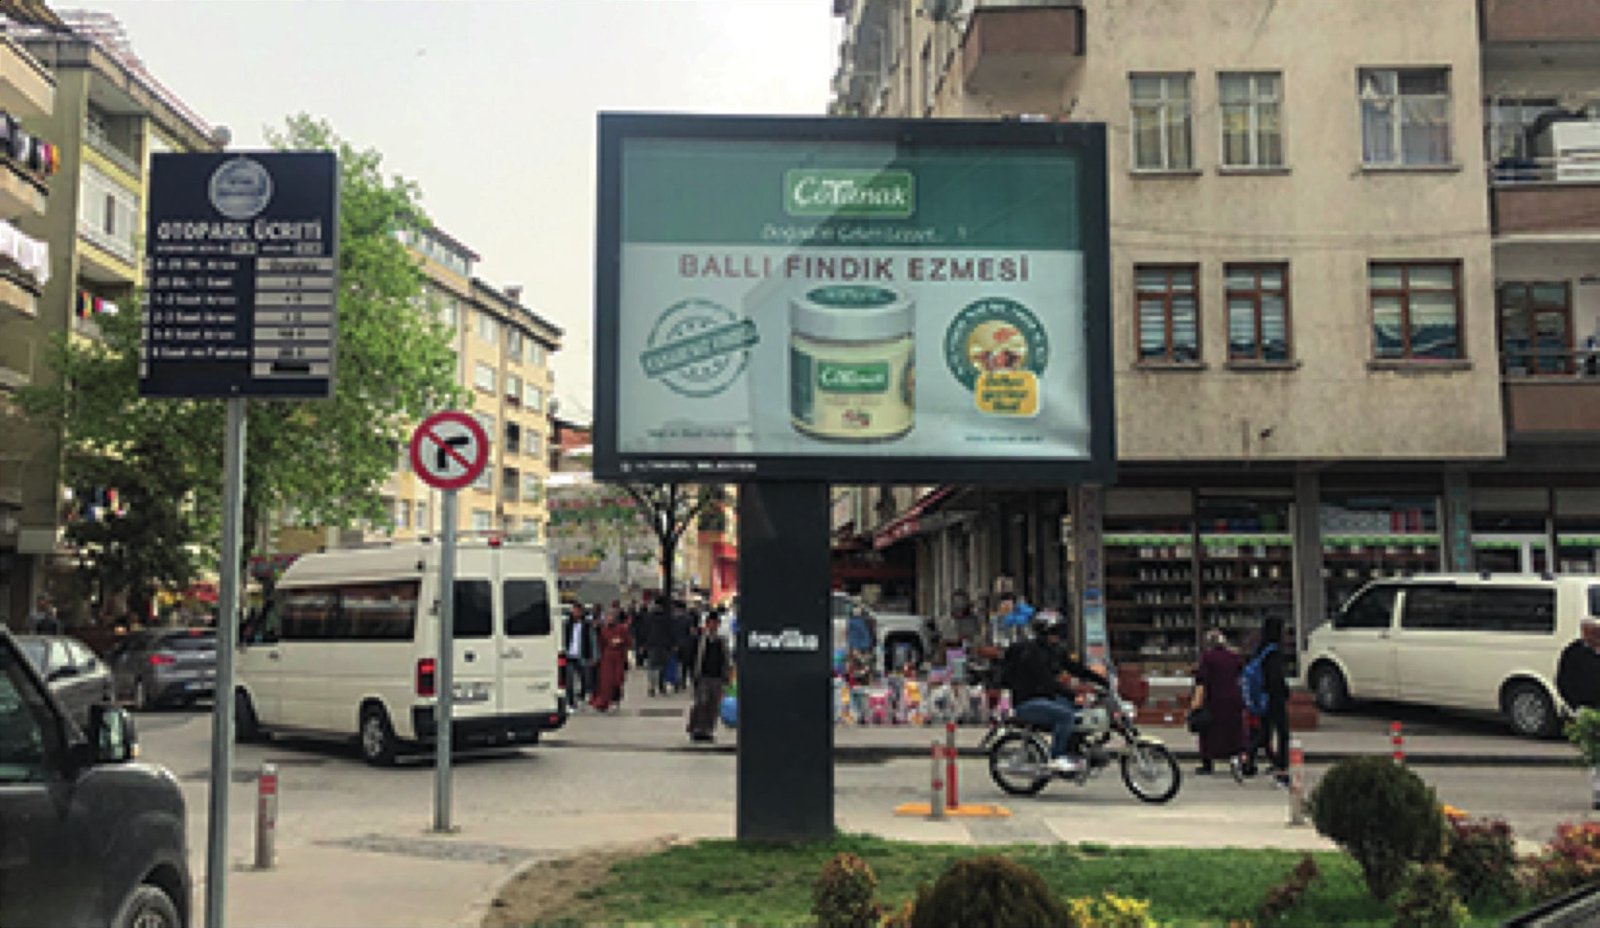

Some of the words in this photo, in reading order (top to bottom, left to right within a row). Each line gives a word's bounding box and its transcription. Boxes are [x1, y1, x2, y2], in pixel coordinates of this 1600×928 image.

[157, 221, 248, 240] OTOPARK
[679, 253, 773, 279] BALLI
[785, 255, 894, 281] FINDIK
[906, 253, 1030, 283] EZMESİ
